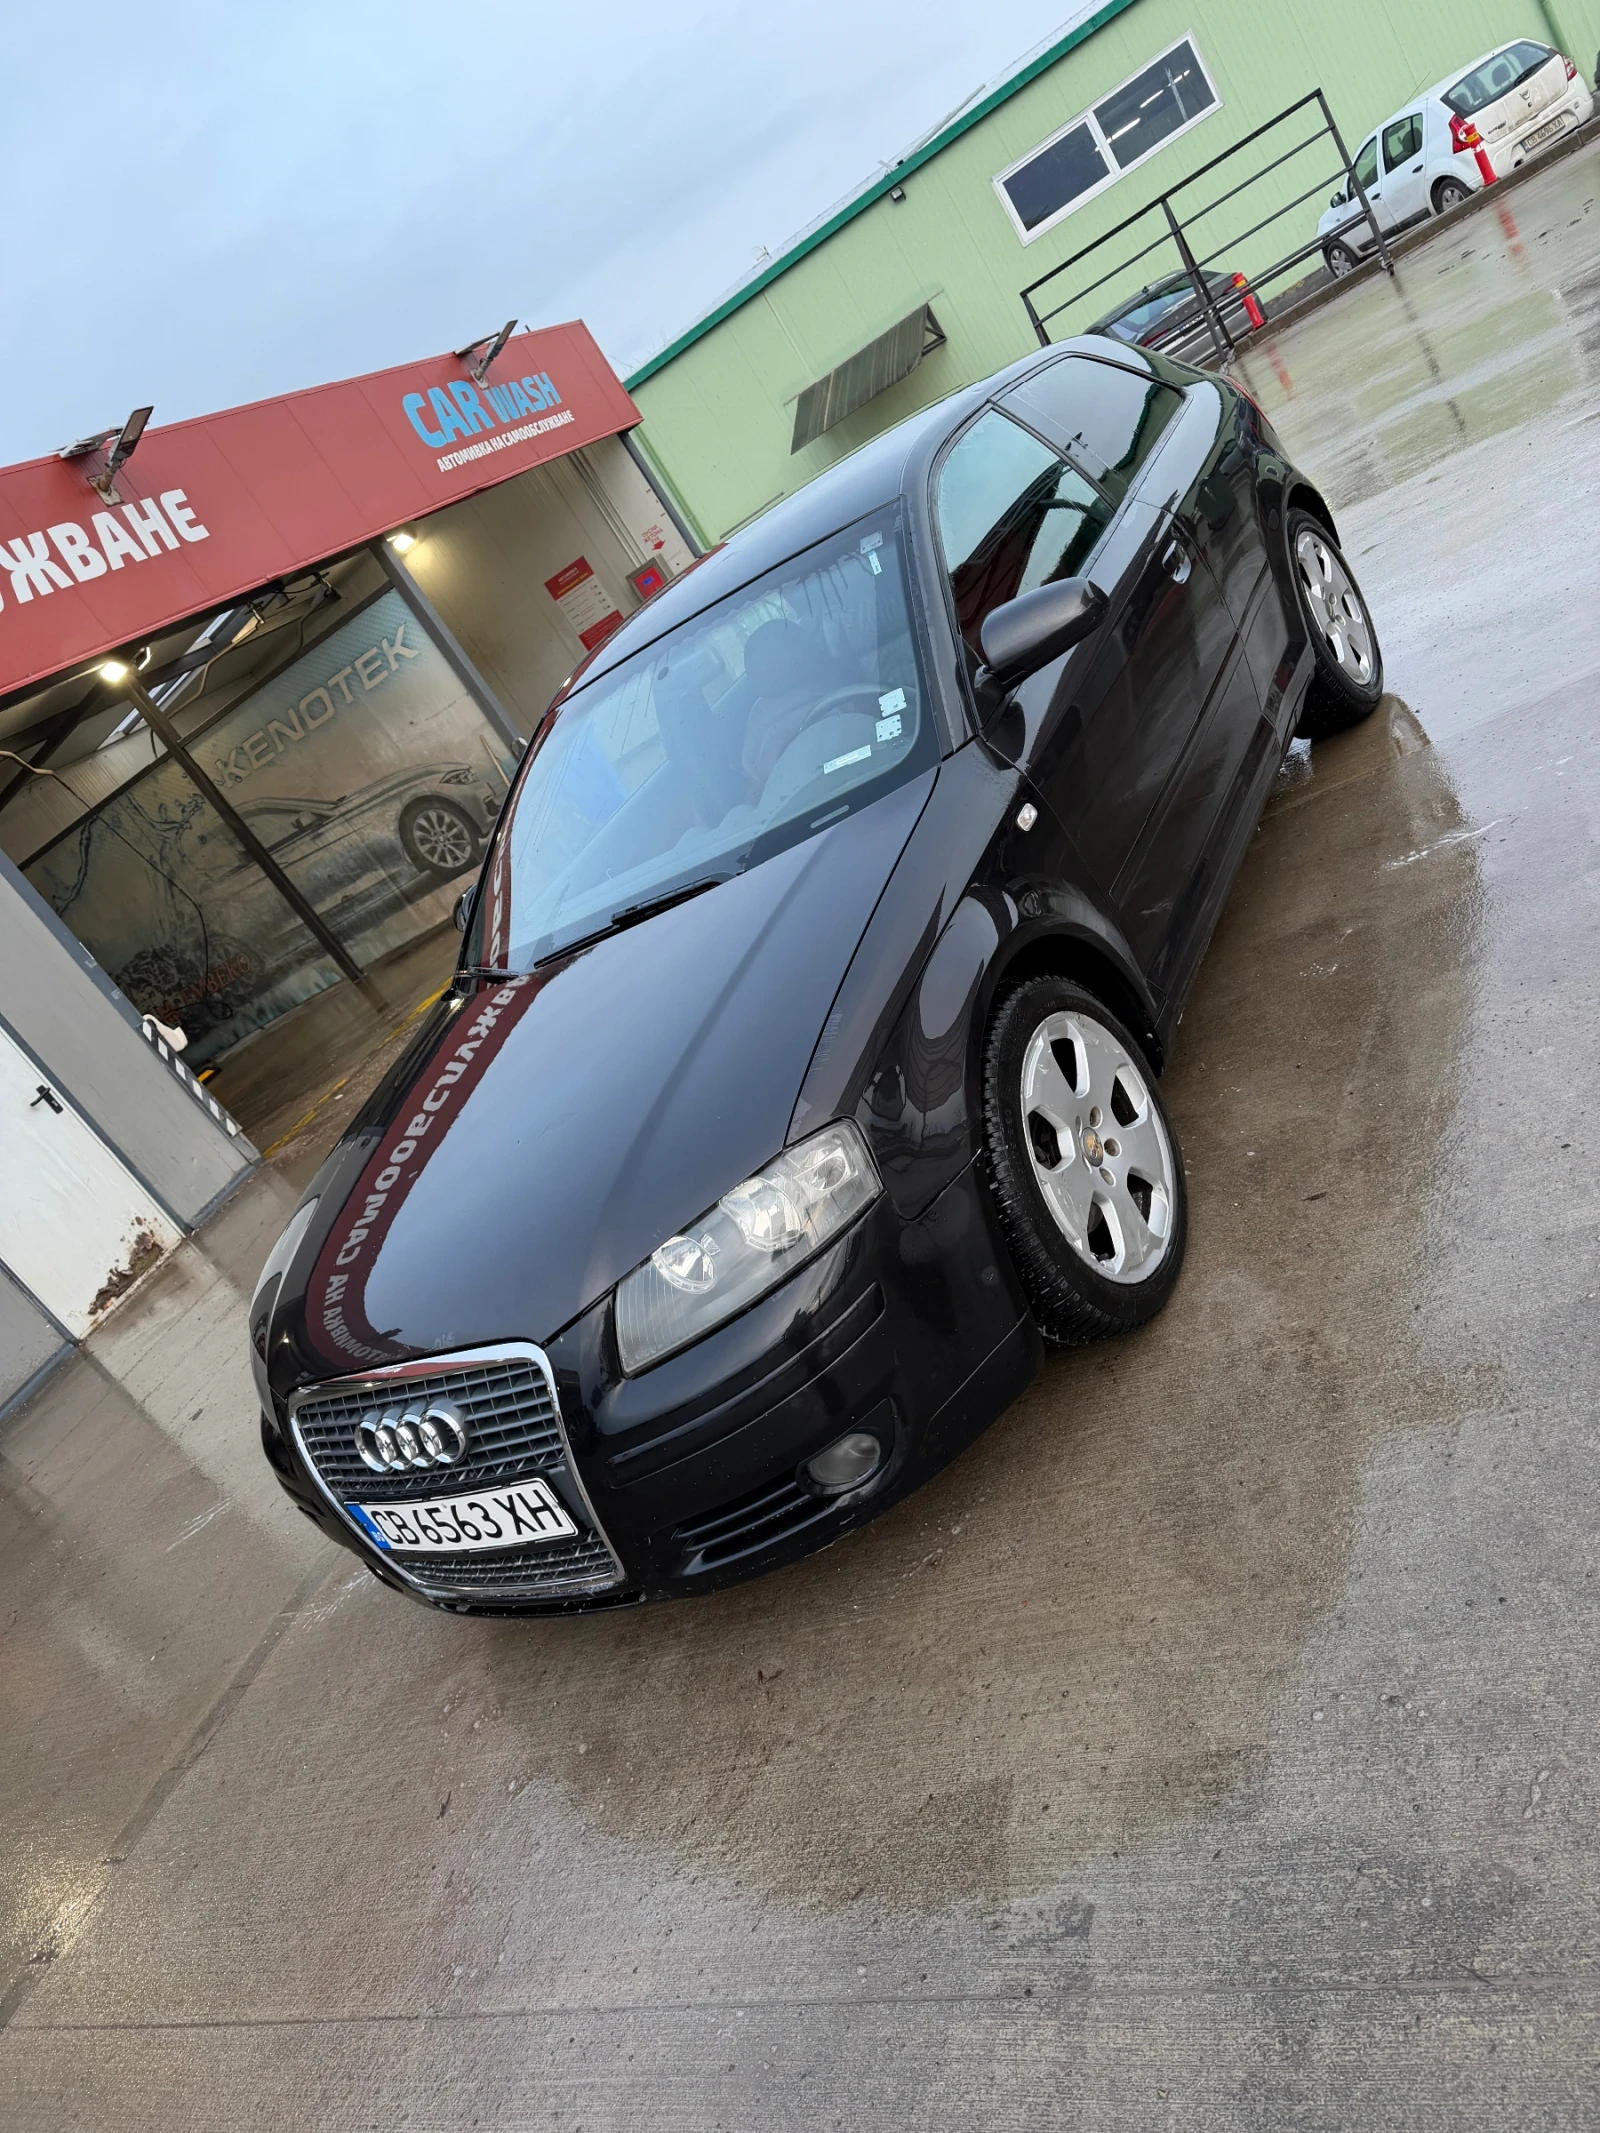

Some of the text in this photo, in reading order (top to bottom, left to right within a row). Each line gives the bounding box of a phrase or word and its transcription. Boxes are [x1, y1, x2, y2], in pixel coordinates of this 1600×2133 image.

[402, 371, 562, 448] CAR WASH
[437, 409, 575, 473] АВТОМИВКА НА САМООБСЛУЖВАНЕ
[0, 488, 210, 612] ЖВАНЕ
[214, 622, 420, 788] KENOTEK
[370, 1489, 564, 1545] CB 6563 XH
